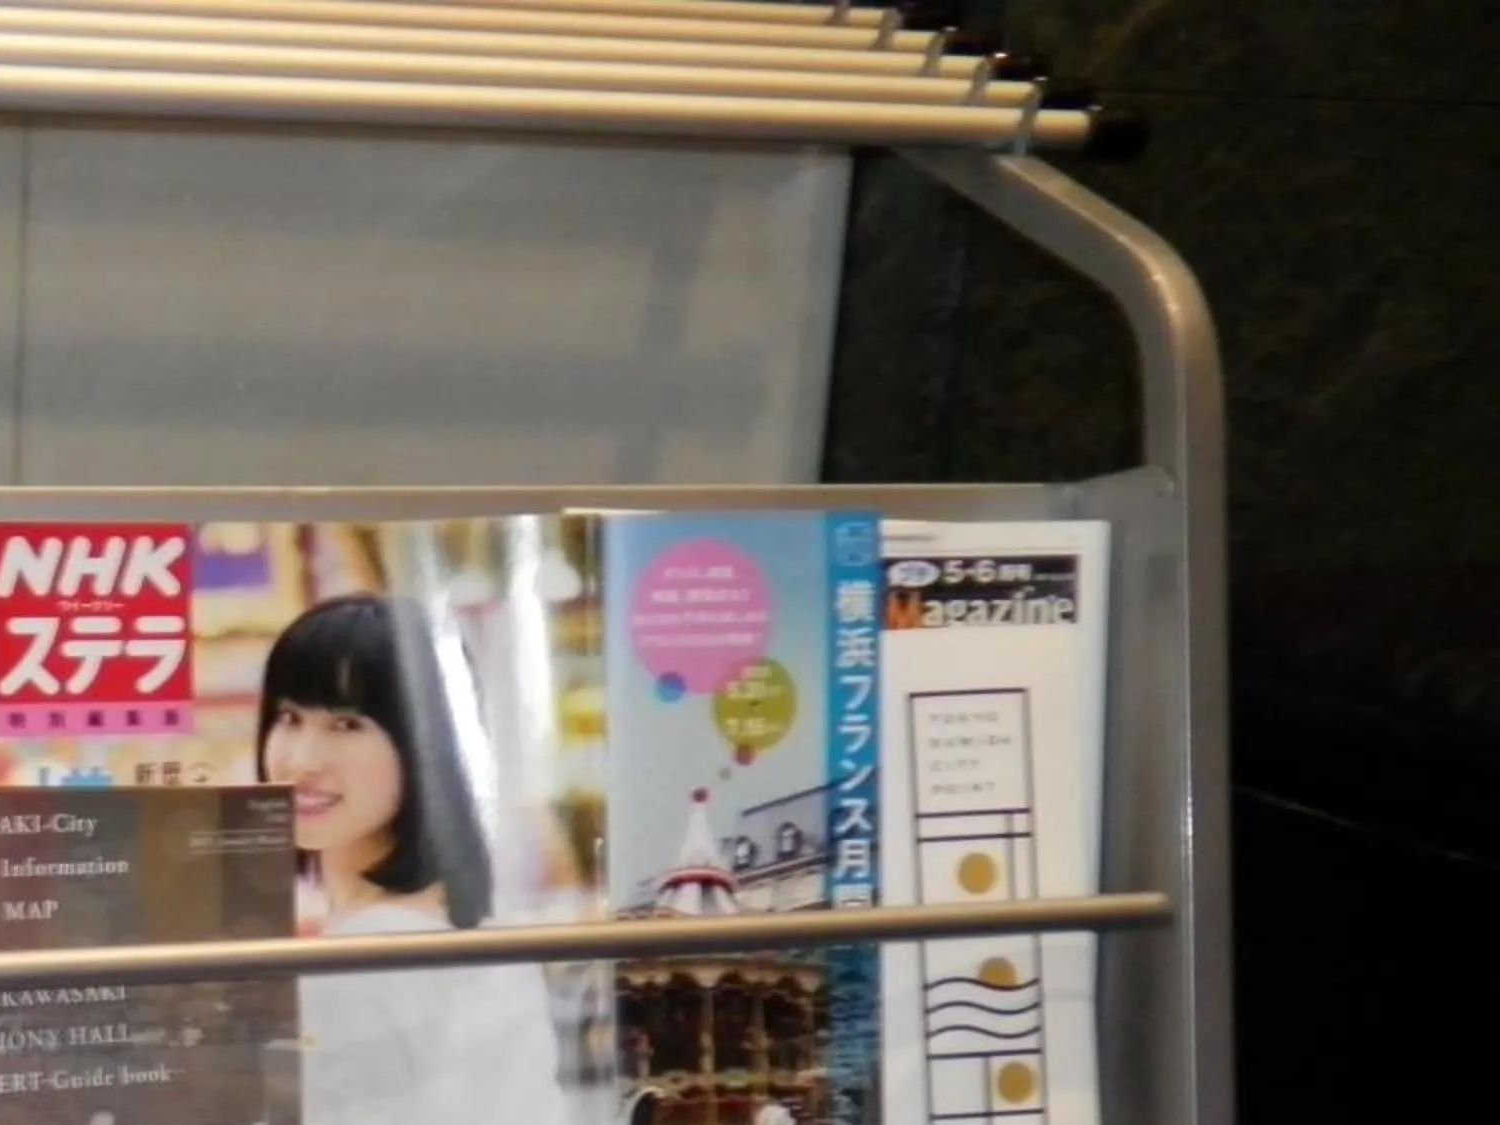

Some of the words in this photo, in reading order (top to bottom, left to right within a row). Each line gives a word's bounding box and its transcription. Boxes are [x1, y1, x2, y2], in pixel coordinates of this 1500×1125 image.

[1, 857, 130, 879] Information
[2, 900, 60, 921] MAP
[68, 1023, 130, 1045] HALL
